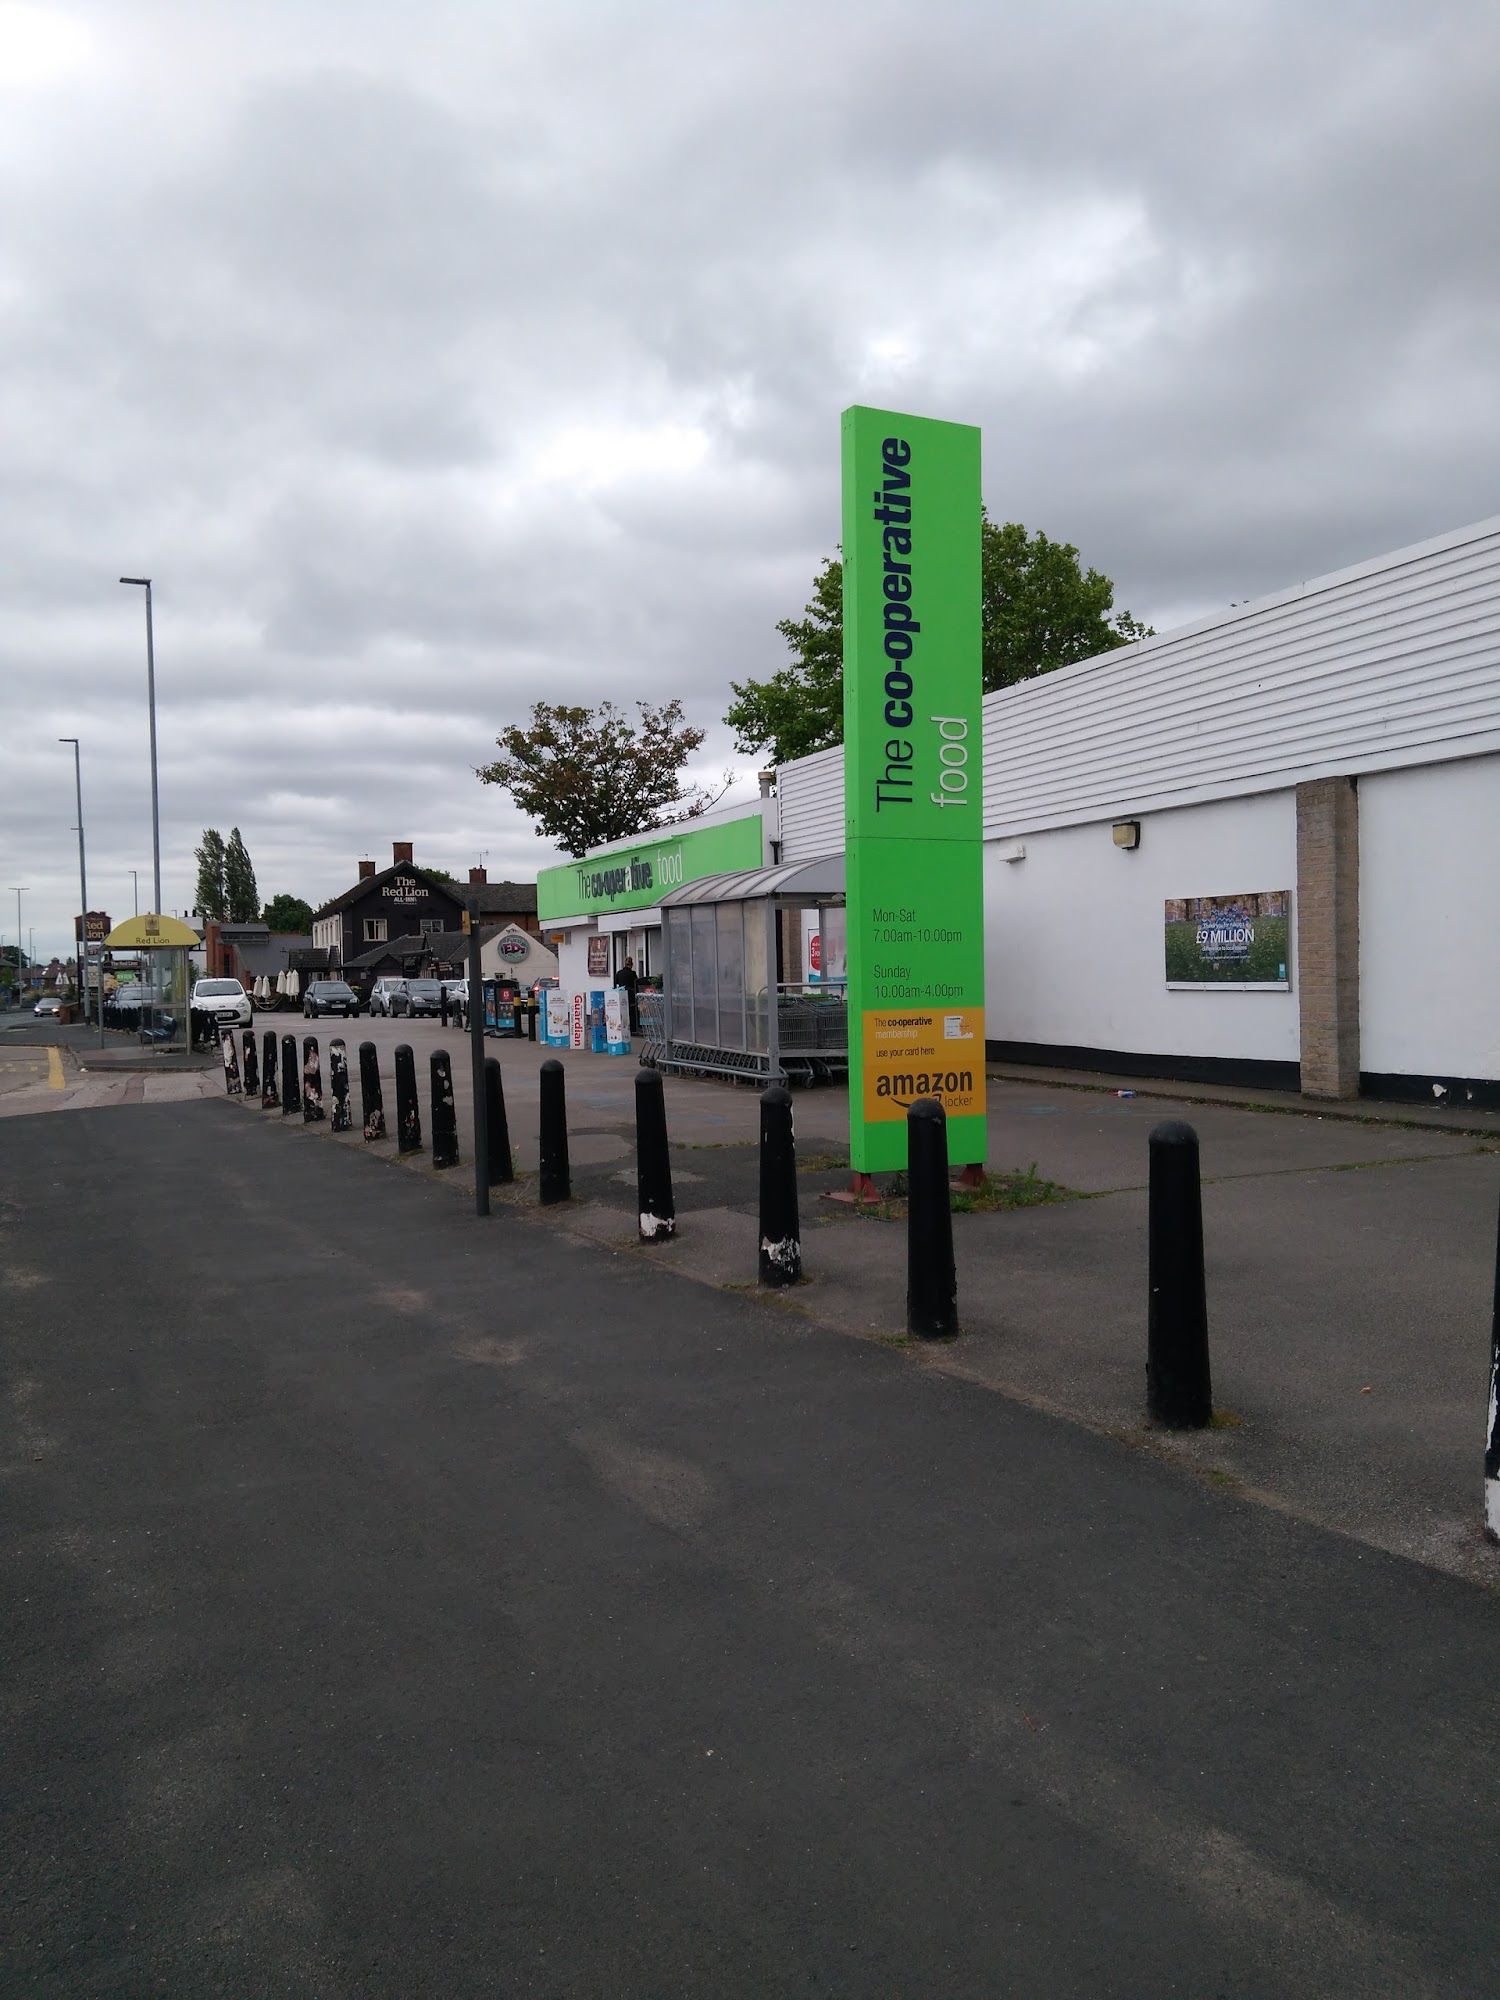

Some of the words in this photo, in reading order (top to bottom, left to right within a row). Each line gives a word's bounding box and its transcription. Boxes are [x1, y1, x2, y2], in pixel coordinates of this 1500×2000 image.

[873, 437, 922, 728] co-operative
[929, 716, 969, 809] food
[876, 739, 914, 813] The
[394, 876, 416, 887] The
[577, 869, 591, 900] The
[591, 856, 654, 903] co-operative
[657, 844, 683, 885] food
[381, 886, 404, 897] Red
[405, 886, 430, 897] Lion
[873, 908, 917, 923] Mon-Sat
[873, 928, 963, 945] 7.00am-10.00pm
[1195, 930, 1209, 944] £9
[1210, 928, 1255, 944] MILLION
[873, 964, 911, 981] Sunday
[875, 983, 964, 999] 10.00am-4.00pm
[574, 994, 583, 1047] Guardian
[874, 1018, 887, 1028] The
[887, 1017, 933, 1028] co-operative
[875, 1029, 918, 1040] membership
[876, 1049, 888, 1058] use
[889, 1048, 903, 1059] your
[904, 1046, 920, 1056] card
[920, 1046, 935, 1055] here
[876, 1070, 973, 1097] amazon
[944, 1095, 973, 1107] locker
